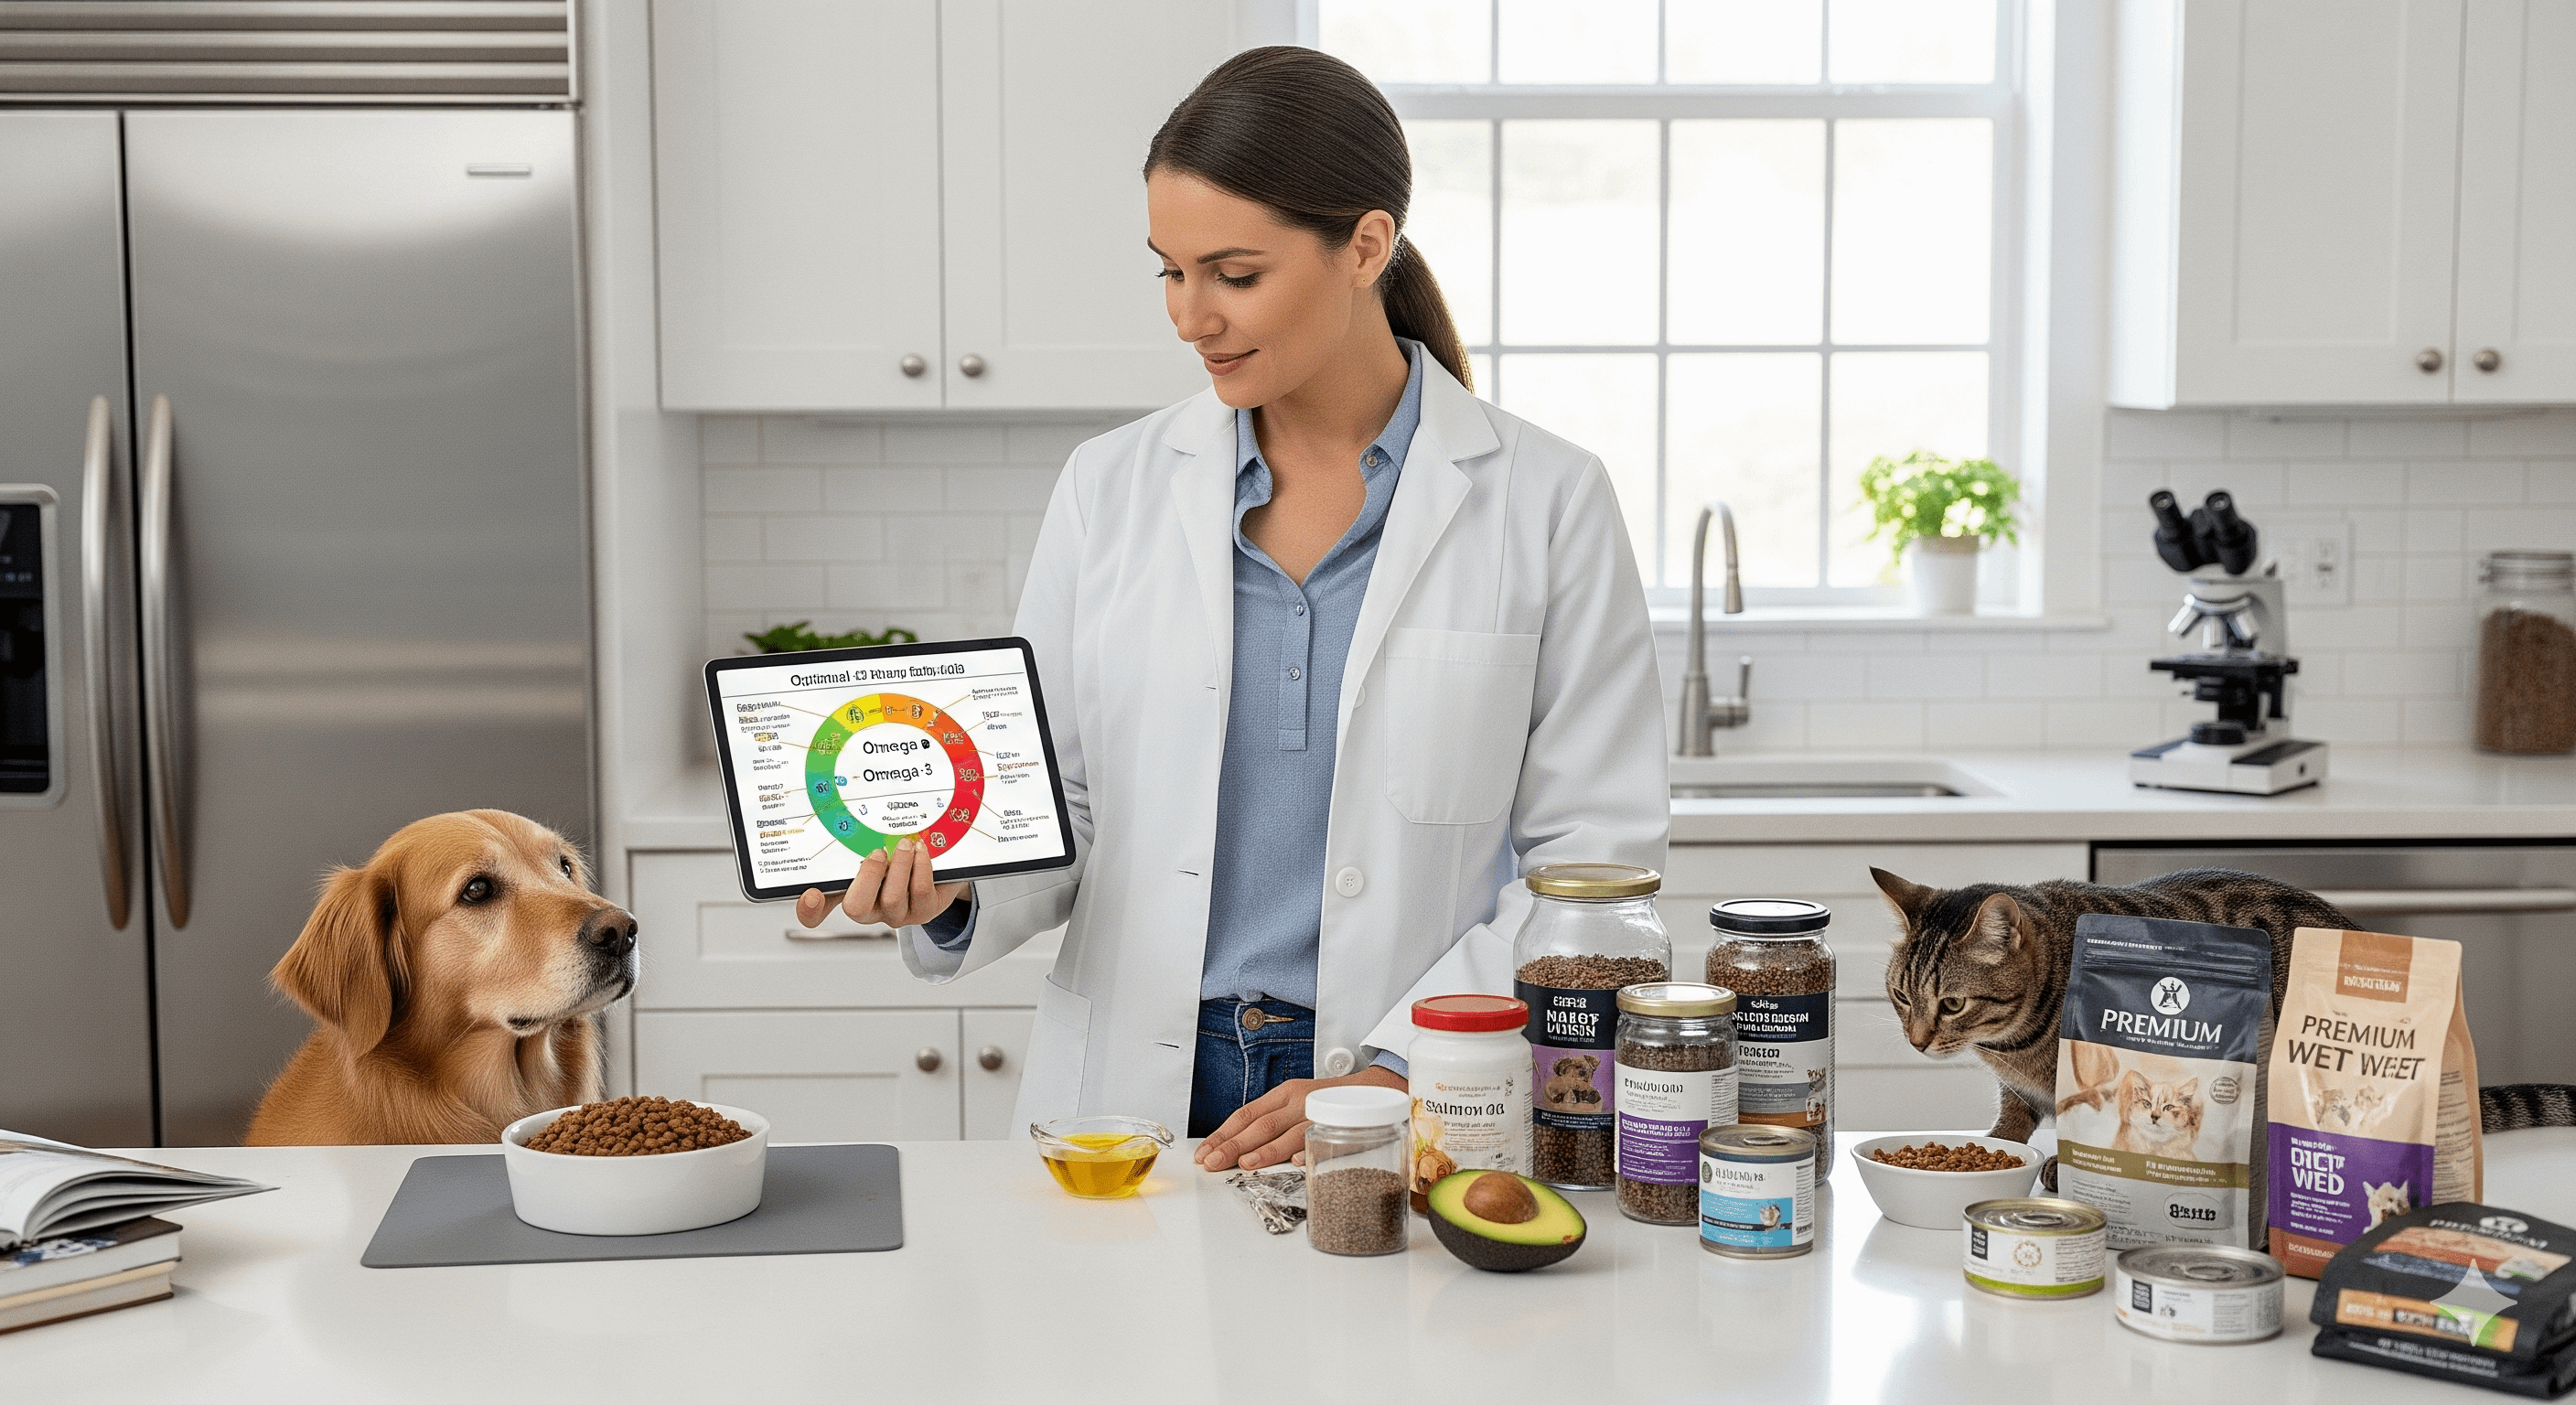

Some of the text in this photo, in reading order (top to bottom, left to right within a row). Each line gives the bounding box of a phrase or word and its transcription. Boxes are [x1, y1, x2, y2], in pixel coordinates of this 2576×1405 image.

[863, 741, 918, 756] Omega
[2100, 1008, 2223, 1044] PREMIUM
[2301, 1014, 2416, 1050] PREMIUM
[2288, 1039, 2354, 1072] WET
[2292, 1166, 2345, 1196] WED
